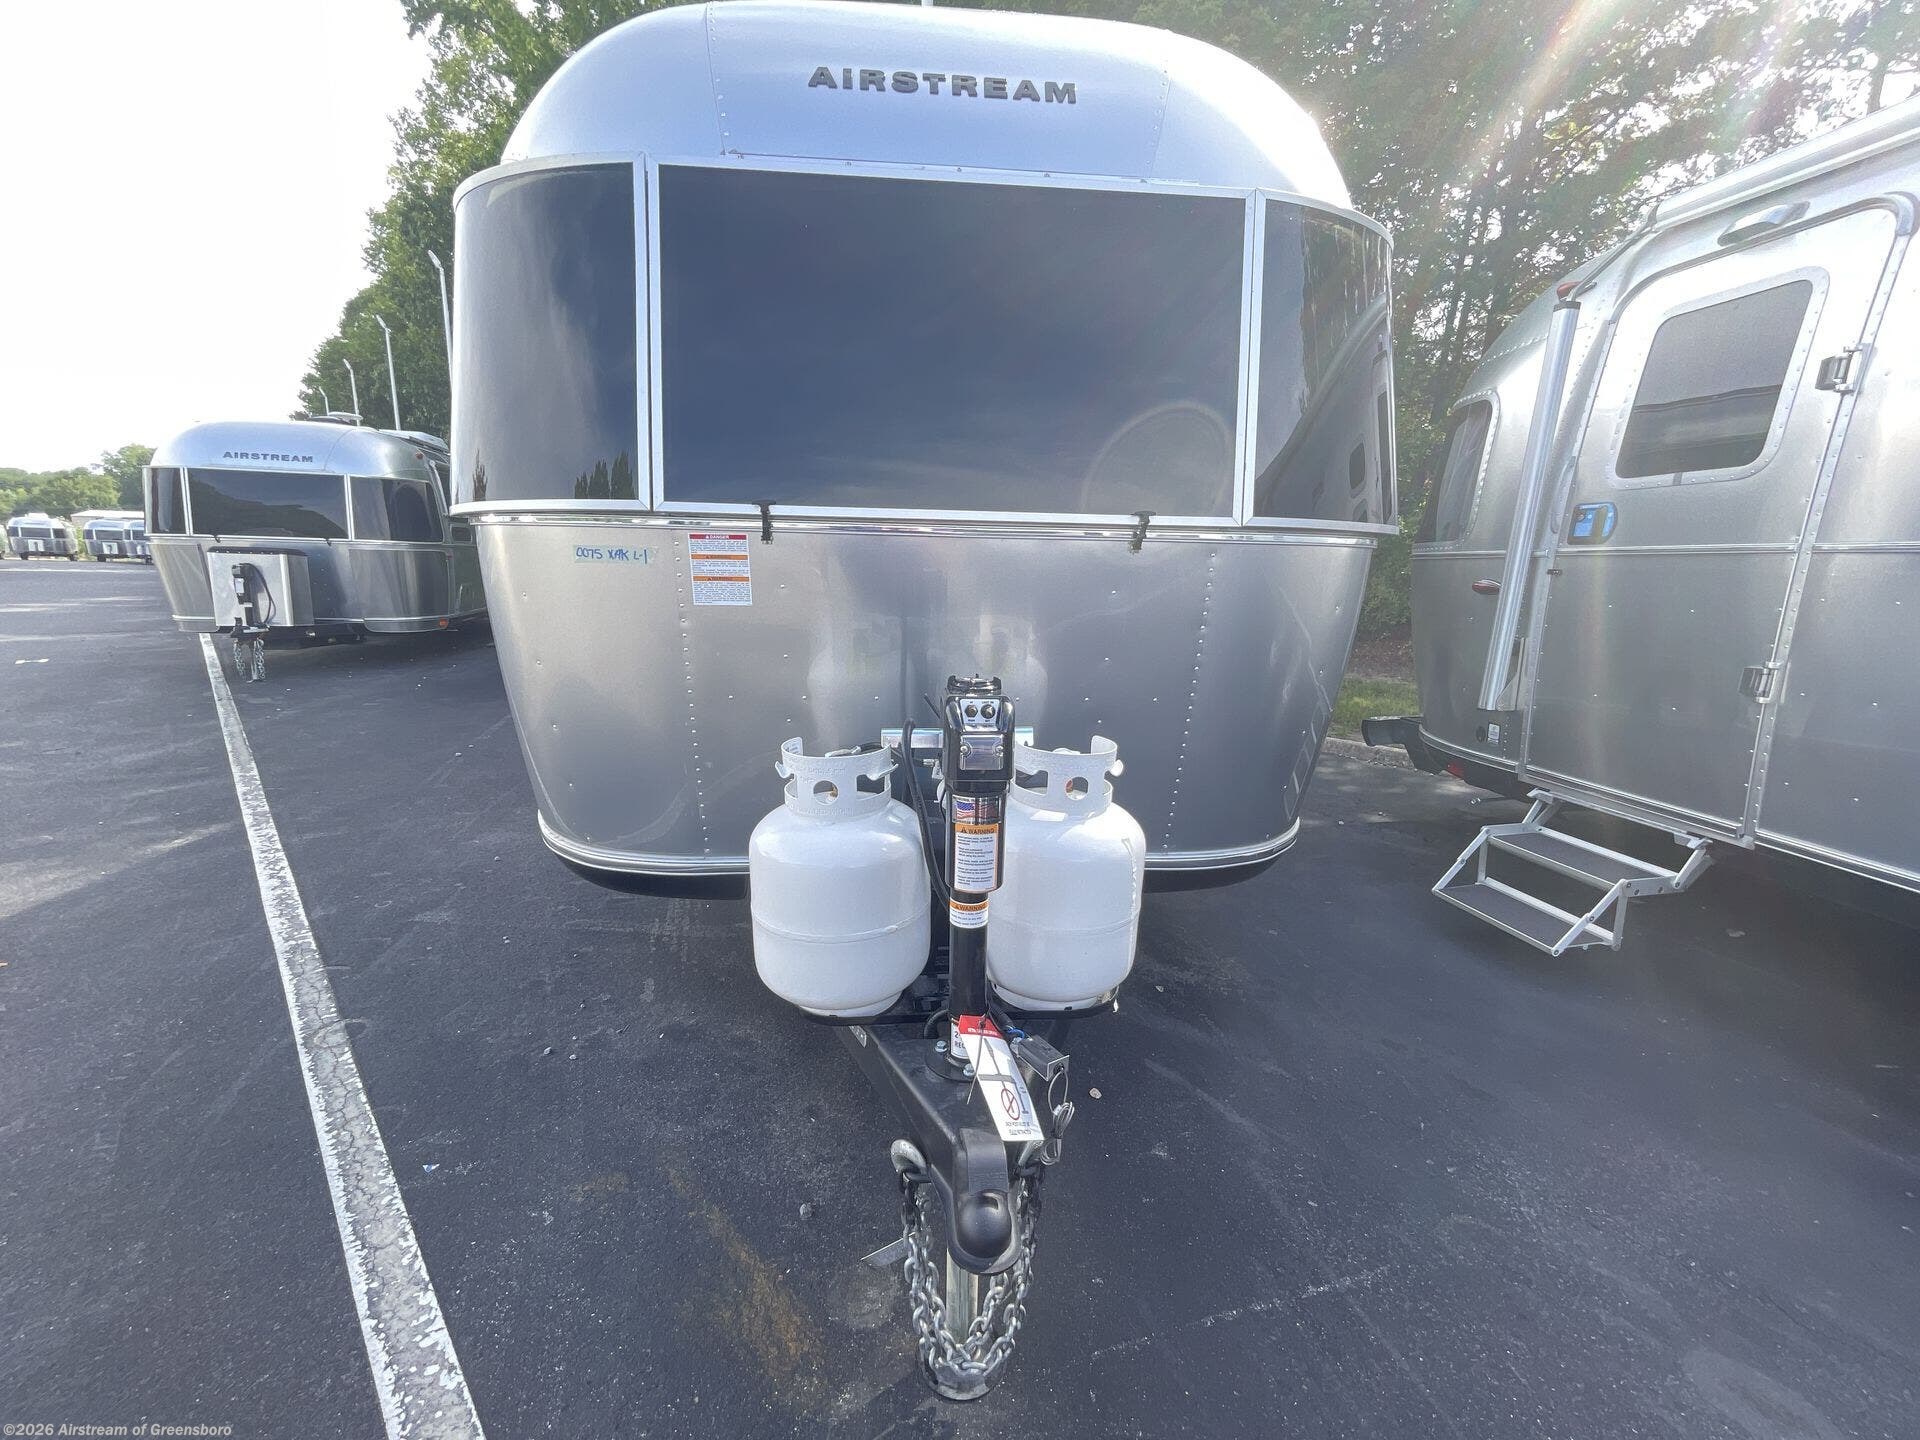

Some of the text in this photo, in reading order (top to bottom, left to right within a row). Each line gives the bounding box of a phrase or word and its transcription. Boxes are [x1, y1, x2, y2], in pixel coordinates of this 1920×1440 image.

[808, 66, 1077, 104] AIRSTREAM
[222, 451, 314, 463] AIRSTREAM
[968, 827, 995, 835] WARNING
[960, 902, 987, 912] WARNING
